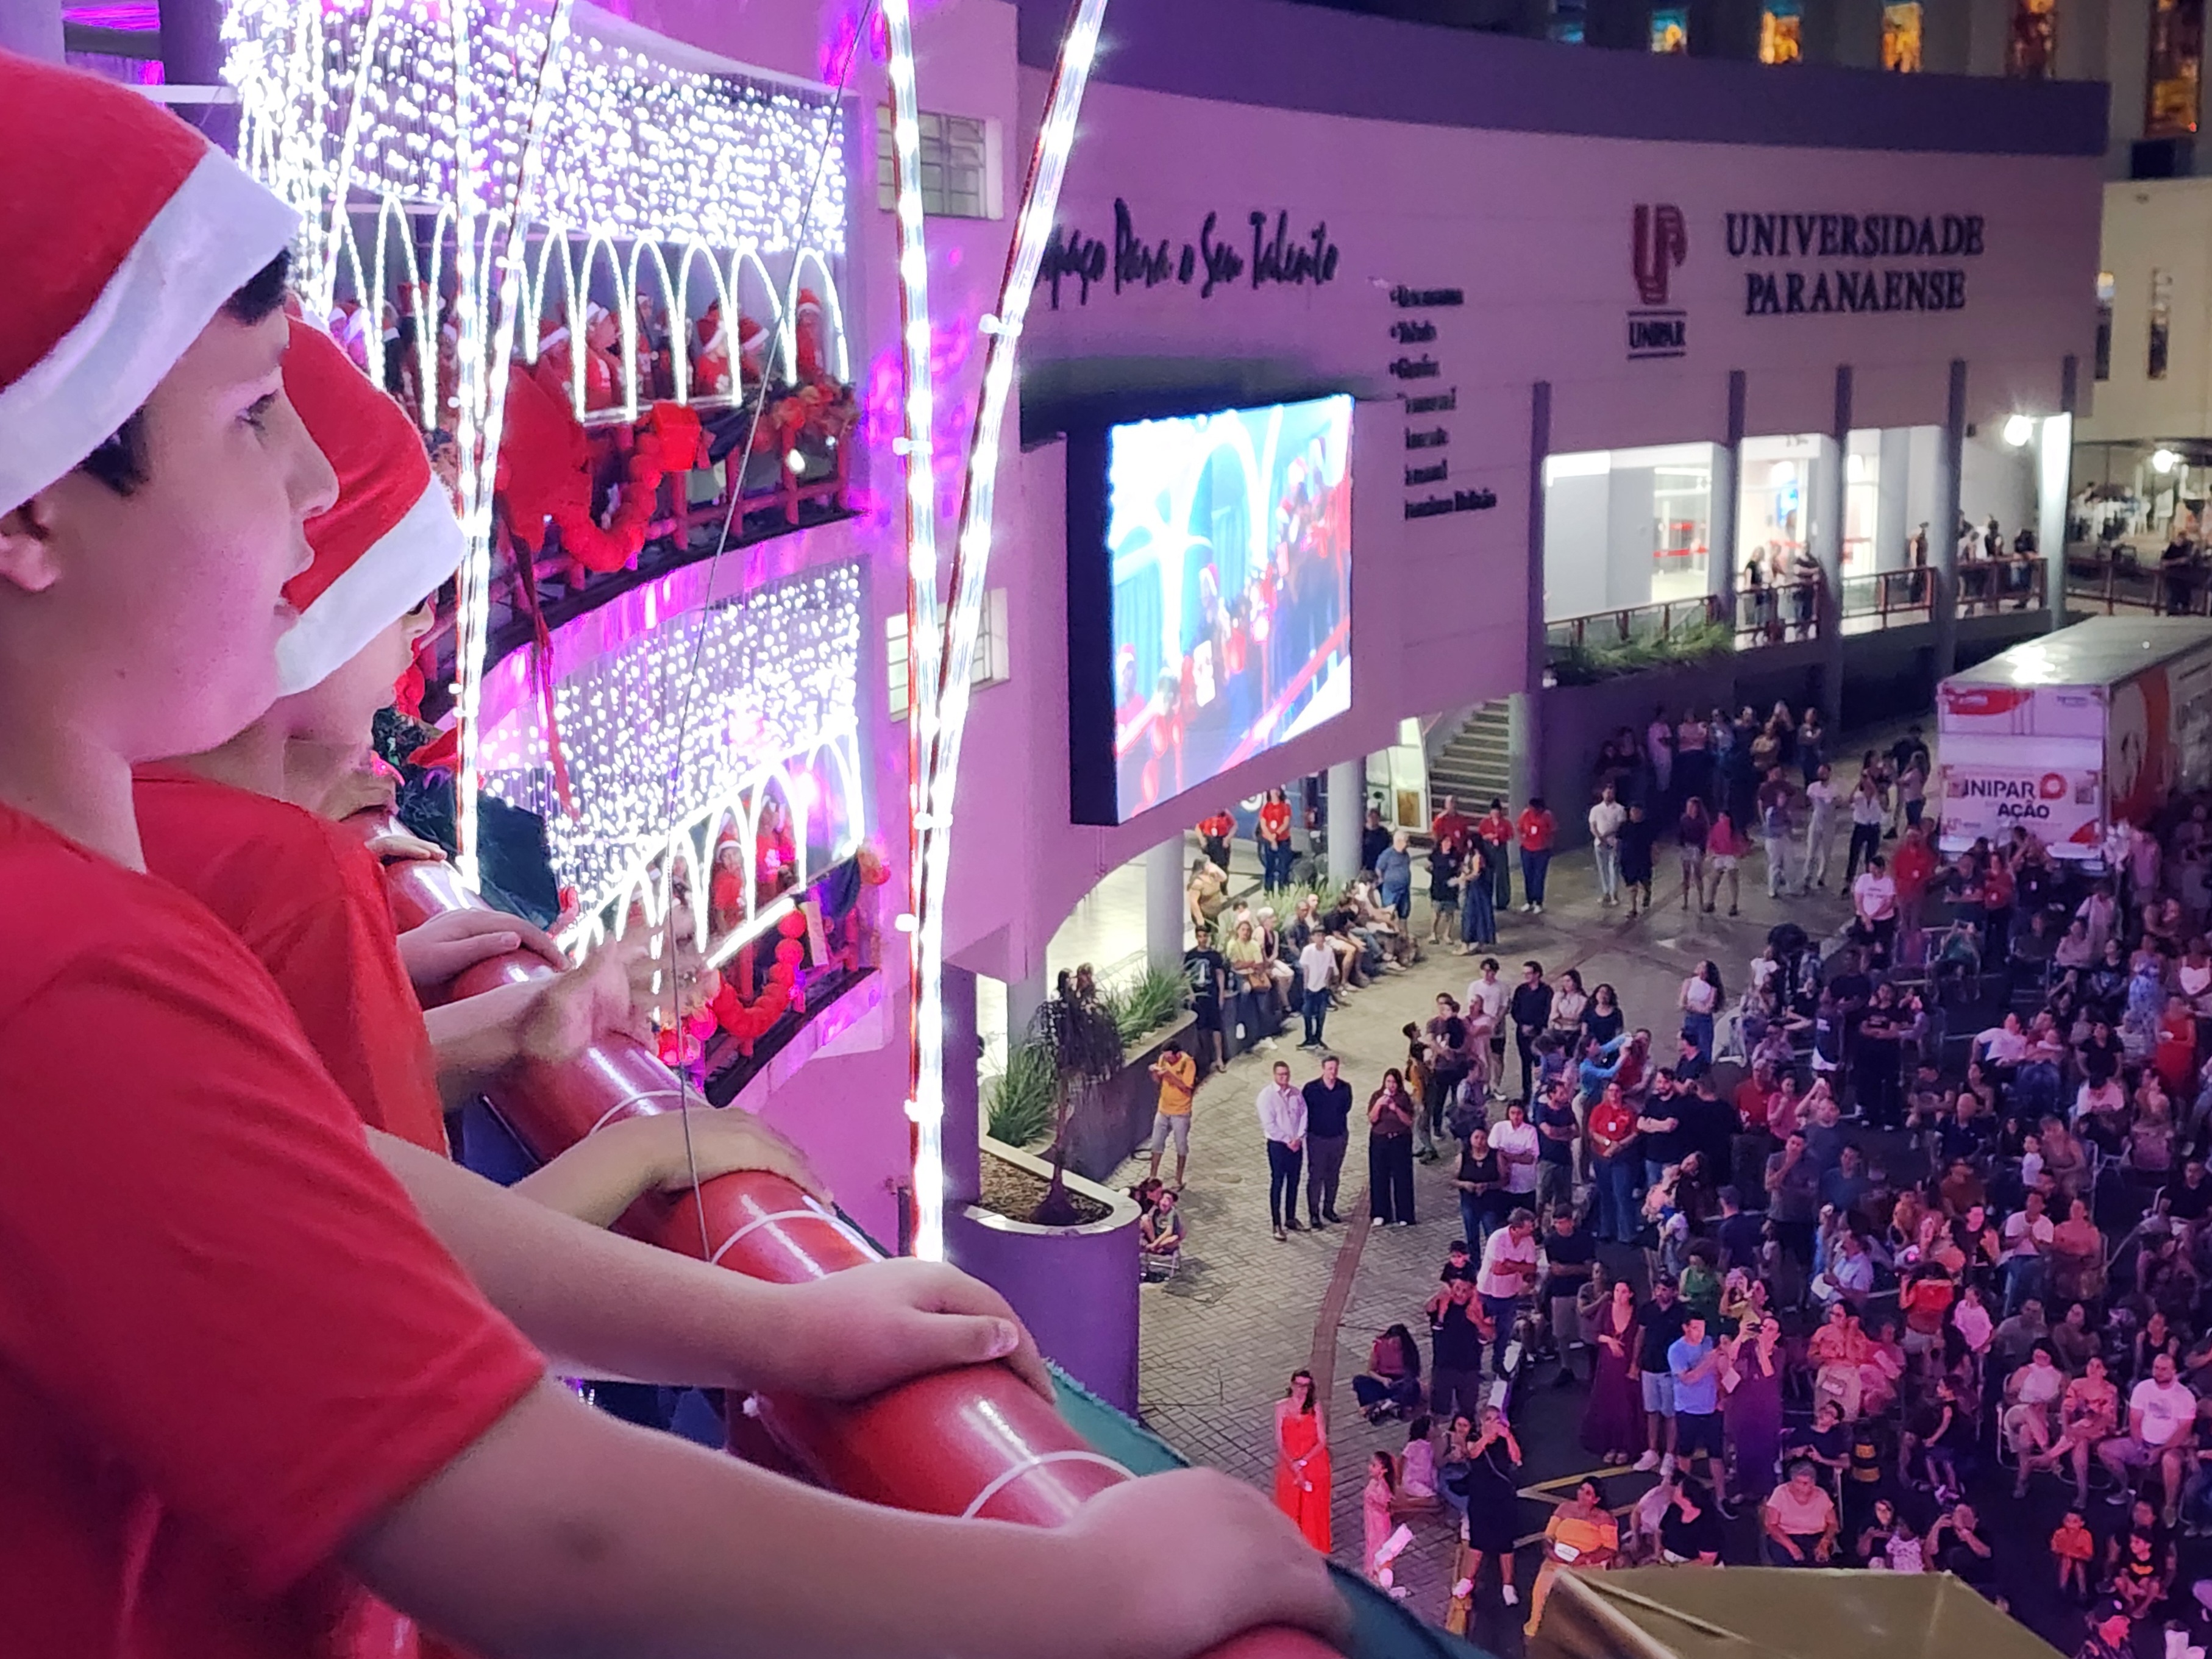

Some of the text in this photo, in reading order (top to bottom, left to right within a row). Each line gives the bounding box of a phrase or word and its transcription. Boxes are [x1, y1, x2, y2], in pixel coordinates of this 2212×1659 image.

[1726, 212, 1985, 258] UNIVERSIDADE
[1745, 269, 1966, 316] PARANAENSE
[1997, 799, 2050, 820] AÇÃO
